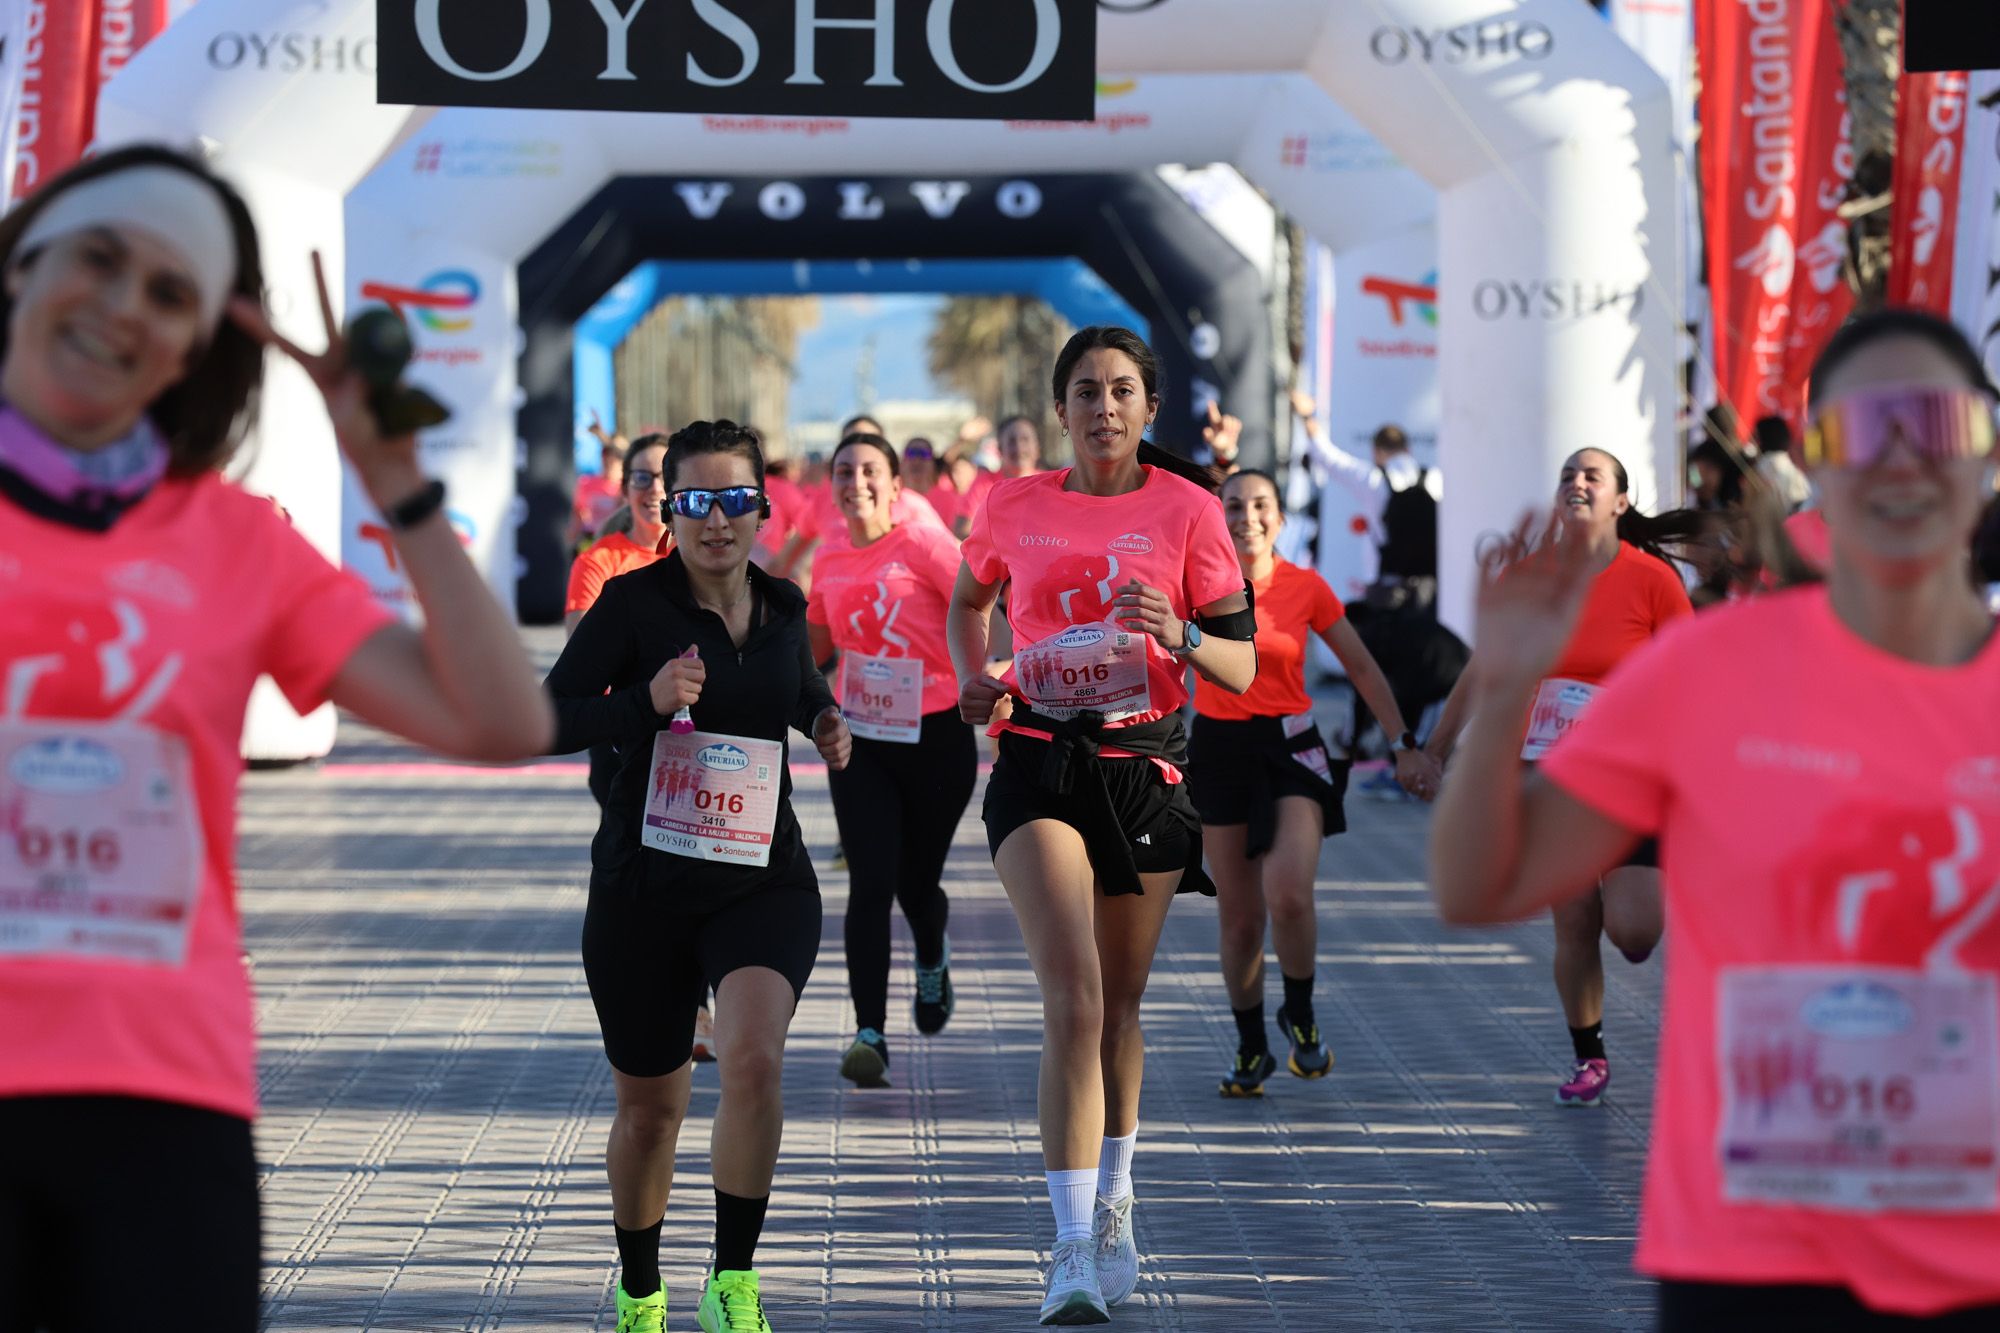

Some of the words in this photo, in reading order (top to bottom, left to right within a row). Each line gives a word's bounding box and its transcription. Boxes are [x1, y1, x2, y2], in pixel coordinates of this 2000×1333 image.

[413, 0, 1061, 93] OYSHO
[1369, 21, 1553, 66] OYSHO
[675, 180, 1042, 221] VOLVO
[1019, 535, 1069, 548] OYSHO
[1111, 541, 1149, 550] ASTURIANA
[1057, 632, 1101, 645] ASTURIANA
[1062, 664, 1109, 685] 016
[1074, 687, 1097, 697] 4869
[1084, 697, 1104, 705] MUJER
[1107, 689, 1133, 700] VALENCIA
[862, 693, 893, 708] 016
[1103, 702, 1137, 716] Santander
[700, 751, 745, 767] ASTURIANA
[695, 790, 744, 813] 016
[701, 816, 726, 827] 3410
[661, 819, 688, 832] CARRERA
[709, 829, 729, 838] MUJER
[735, 833, 761, 841] VALENCIA
[656, 832, 697, 850] OYSHO
[724, 846, 762, 858] Santander
